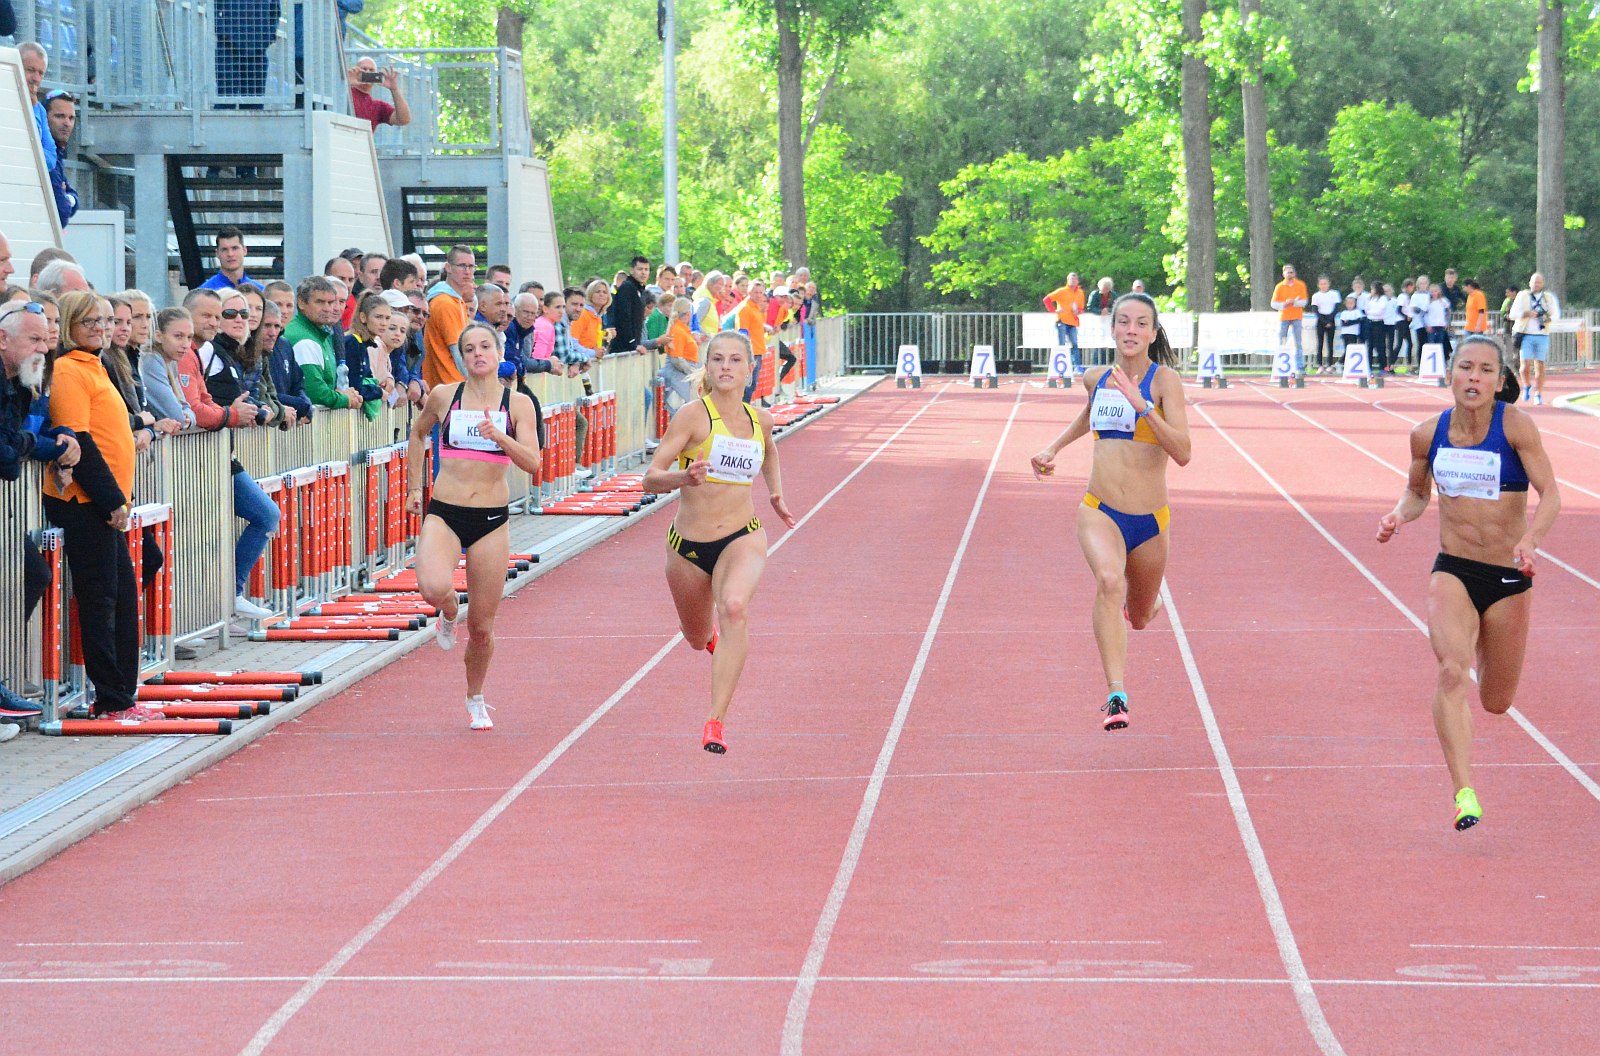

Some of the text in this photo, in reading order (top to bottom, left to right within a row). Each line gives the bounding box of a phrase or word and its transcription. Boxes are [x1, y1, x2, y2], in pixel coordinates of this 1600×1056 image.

[901, 352, 916, 374] 8
[976, 352, 991, 374] 7
[1053, 352, 1067, 374] 6
[1202, 352, 1218, 375] 4
[1277, 352, 1292, 373] 3
[1349, 352, 1364, 374] 2
[1426, 352, 1438, 373] 1
[720, 454, 754, 470] TAKÁCS
[1436, 469, 1496, 483] NGUYEN ANASZTÁZIA
